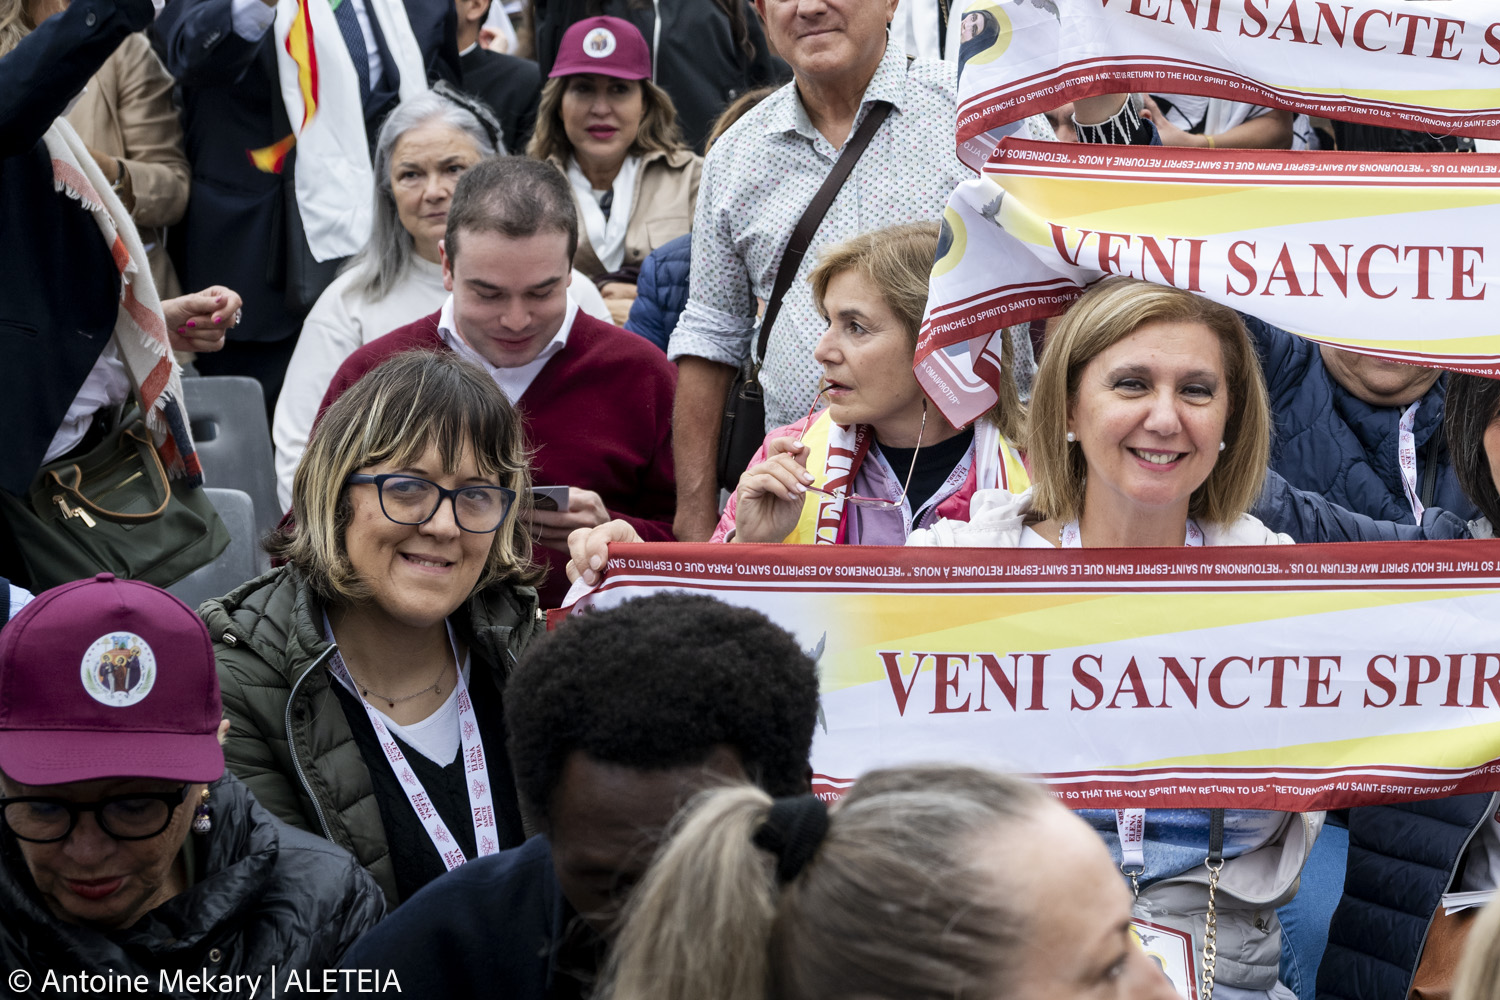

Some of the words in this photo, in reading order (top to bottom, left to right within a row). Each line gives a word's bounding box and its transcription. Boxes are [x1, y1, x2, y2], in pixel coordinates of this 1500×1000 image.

[981, 97, 1015, 117] AFFINCHÉ
[1025, 85, 1054, 101] SPIRITO
[1064, 74, 1094, 87] RITORNI
[1125, 70, 1154, 78] RETURN
[1166, 70, 1182, 79] THE
[1182, 72, 1203, 81] HOLY
[1203, 75, 1228, 86] SPIRIT
[1240, 82, 1259, 93] THAT
[1260, 89, 1274, 99] THE
[1274, 95, 1294, 106] HOLY
[1294, 101, 1319, 110] SPIRIT
[1319, 104, 1336, 112] MAY
[1335, 104, 1367, 114] RETURN
[1112, 156, 1162, 168] RETOURNE
[1160, 159, 1222, 170] SAINT-ESPRIT
[1234, 161, 1255, 170] QUE
[1255, 162, 1284, 171] ENFIN
[1282, 162, 1344, 171] SAINT-ESPRIT
[1459, 164, 1497, 173] RETURN
[1047, 222, 1207, 293] VENI
[1226, 240, 1487, 300] SANCTE
[976, 304, 1007, 322] SPIRITO
[1008, 297, 1036, 311] SANTO
[627, 558, 672, 571] ESPÍRITO
[683, 561, 705, 573] QUE
[706, 563, 733, 574] PARA
[734, 562, 770, 575] SANTO,
[772, 564, 817, 577] ESPÍRITO
[951, 565, 1003, 576] RETOURNE
[1004, 563, 1068, 575] SAINT-ESPRIT
[1083, 563, 1104, 575] QUE
[1105, 563, 1134, 575] ENFIN
[1134, 563, 1198, 574] SAINT-ESPRIT
[1320, 563, 1358, 573] RETURN
[1358, 563, 1379, 573] MAY
[1379, 562, 1409, 573] SPIRIT
[1410, 561, 1434, 573] HOLY
[1435, 561, 1454, 572] THE
[1455, 561, 1479, 571] THAT
[879, 651, 1051, 717] VENI
[1070, 654, 1342, 711] SANCTE
[390, 741, 403, 761] VENI
[470, 745, 478, 773] ELENA
[1079, 788, 1103, 799] THAT
[1103, 789, 1123, 797] THE
[1123, 788, 1147, 798] HOLY
[1148, 785, 1177, 796] SPIRIT
[1178, 784, 1197, 794] MAY
[1198, 784, 1235, 795] RETURN
[1350, 781, 1413, 794] SAINT-ESPRIT
[1413, 786, 1440, 795] ENFIN
[416, 792, 432, 819] ELENA
[472, 807, 482, 828] VENI
[1129, 814, 1137, 842] ELENA
[1135, 814, 1143, 842] GUERRA
